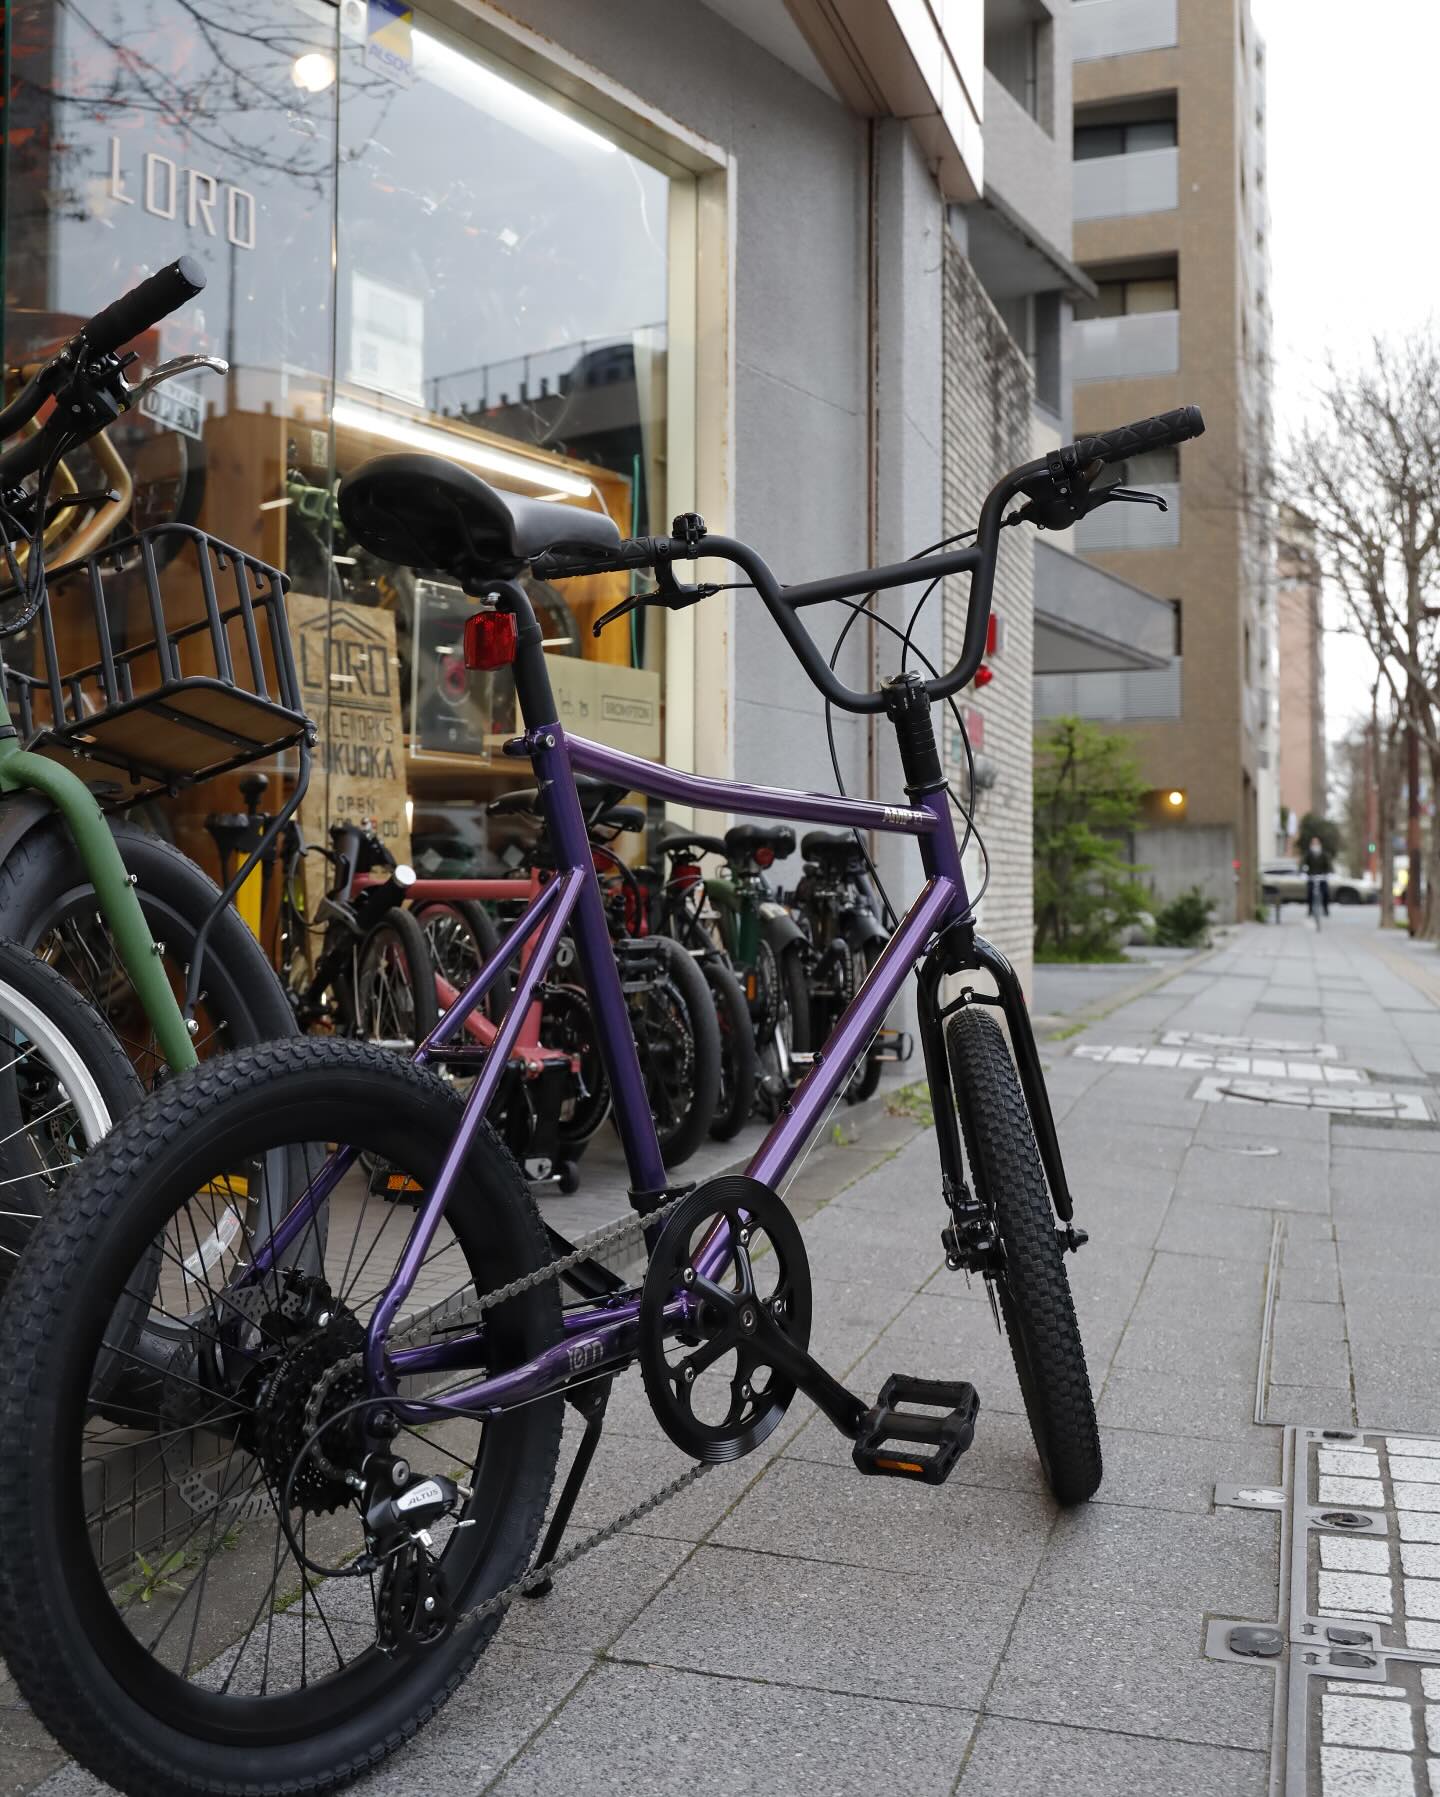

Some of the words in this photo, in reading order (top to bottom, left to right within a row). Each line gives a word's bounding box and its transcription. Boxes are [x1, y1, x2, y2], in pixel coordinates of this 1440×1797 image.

[112, 136, 256, 250] LORO
[146, 391, 199, 433] OPEN
[301, 633, 391, 697] LORO
[336, 795, 376, 815] OPEN
[408, 1488, 439, 1507] ALTUS
